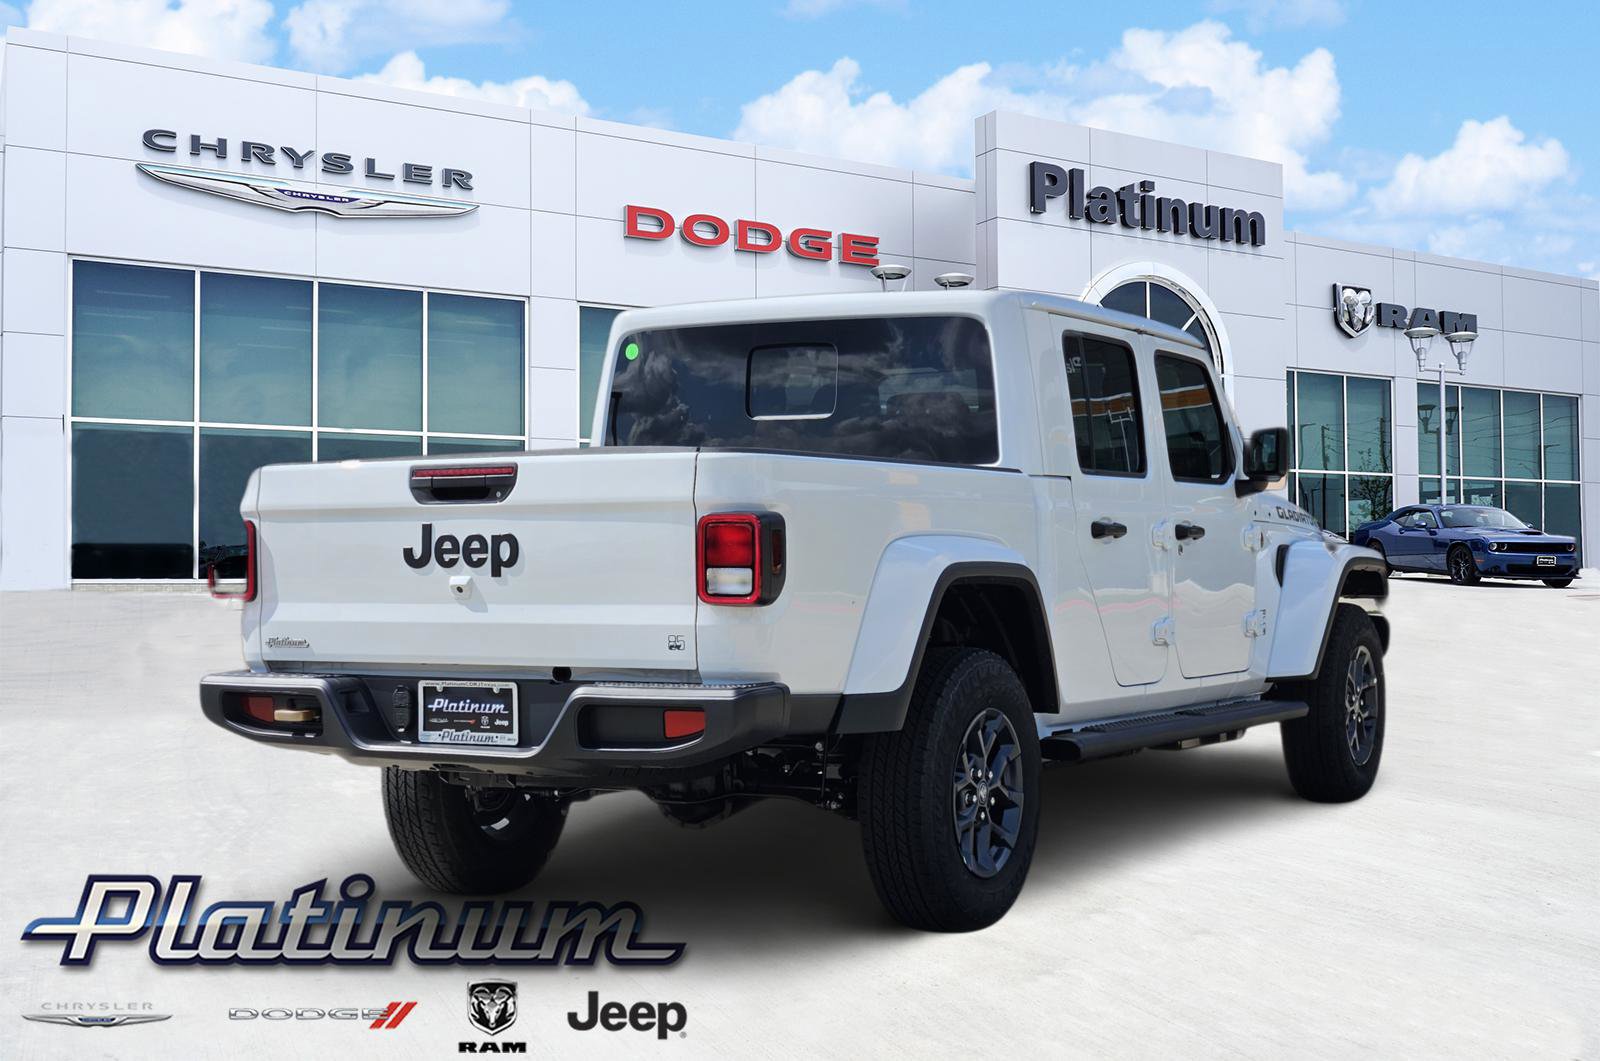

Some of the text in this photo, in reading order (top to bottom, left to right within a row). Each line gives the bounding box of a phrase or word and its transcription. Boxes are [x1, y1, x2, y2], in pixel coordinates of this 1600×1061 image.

[142, 128, 474, 191] CHRYSLER
[284, 190, 350, 203] CHRYSLER
[1029, 160, 1266, 247] Platinum
[624, 204, 880, 266] DODGE
[1376, 302, 1478, 336] RAM
[403, 523, 519, 578] Jeep
[427, 698, 509, 714] Platinum
[494, 719, 509, 727] Jeep
[441, 730, 495, 743] Platinum
